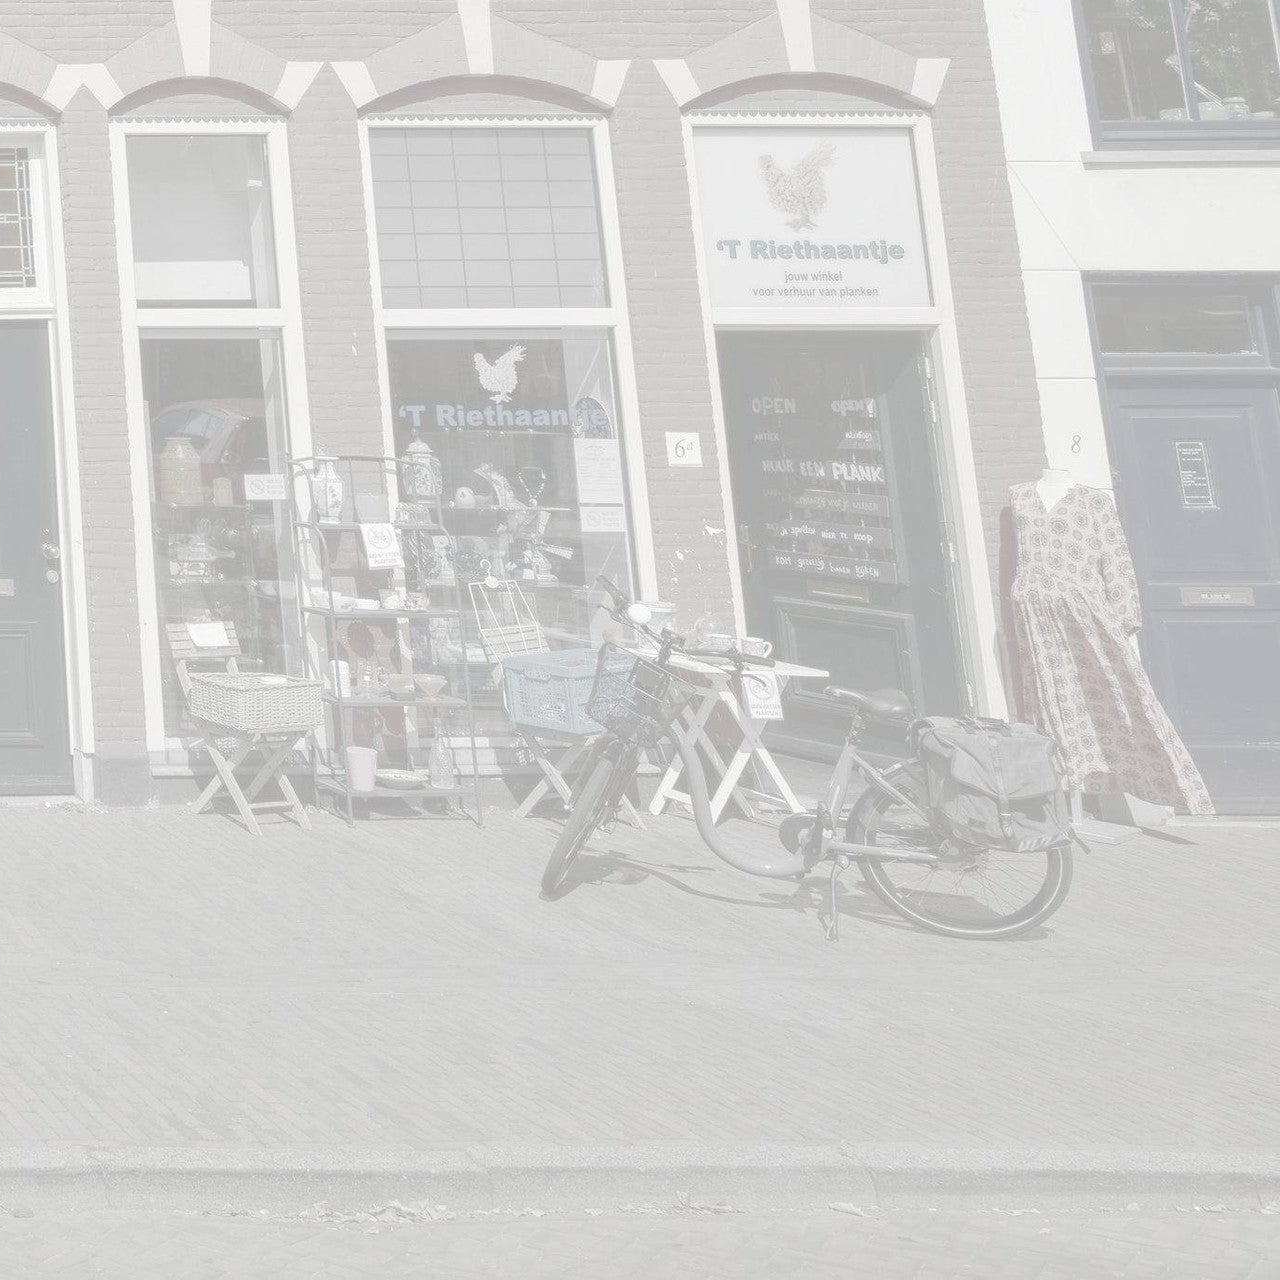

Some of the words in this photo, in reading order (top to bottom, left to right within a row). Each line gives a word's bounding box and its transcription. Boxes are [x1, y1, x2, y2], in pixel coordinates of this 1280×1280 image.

[750, 239, 905, 265] Riethaantje
[783, 271, 809, 283] jouw
[811, 271, 843, 282] winkel
[753, 288, 775, 297] voor
[778, 286, 815, 297] verhuur
[819, 288, 837, 297] van
[839, 286, 879, 298] planken
[1071, 434, 1081, 453] 8
[831, 462, 884, 482] PLANK
